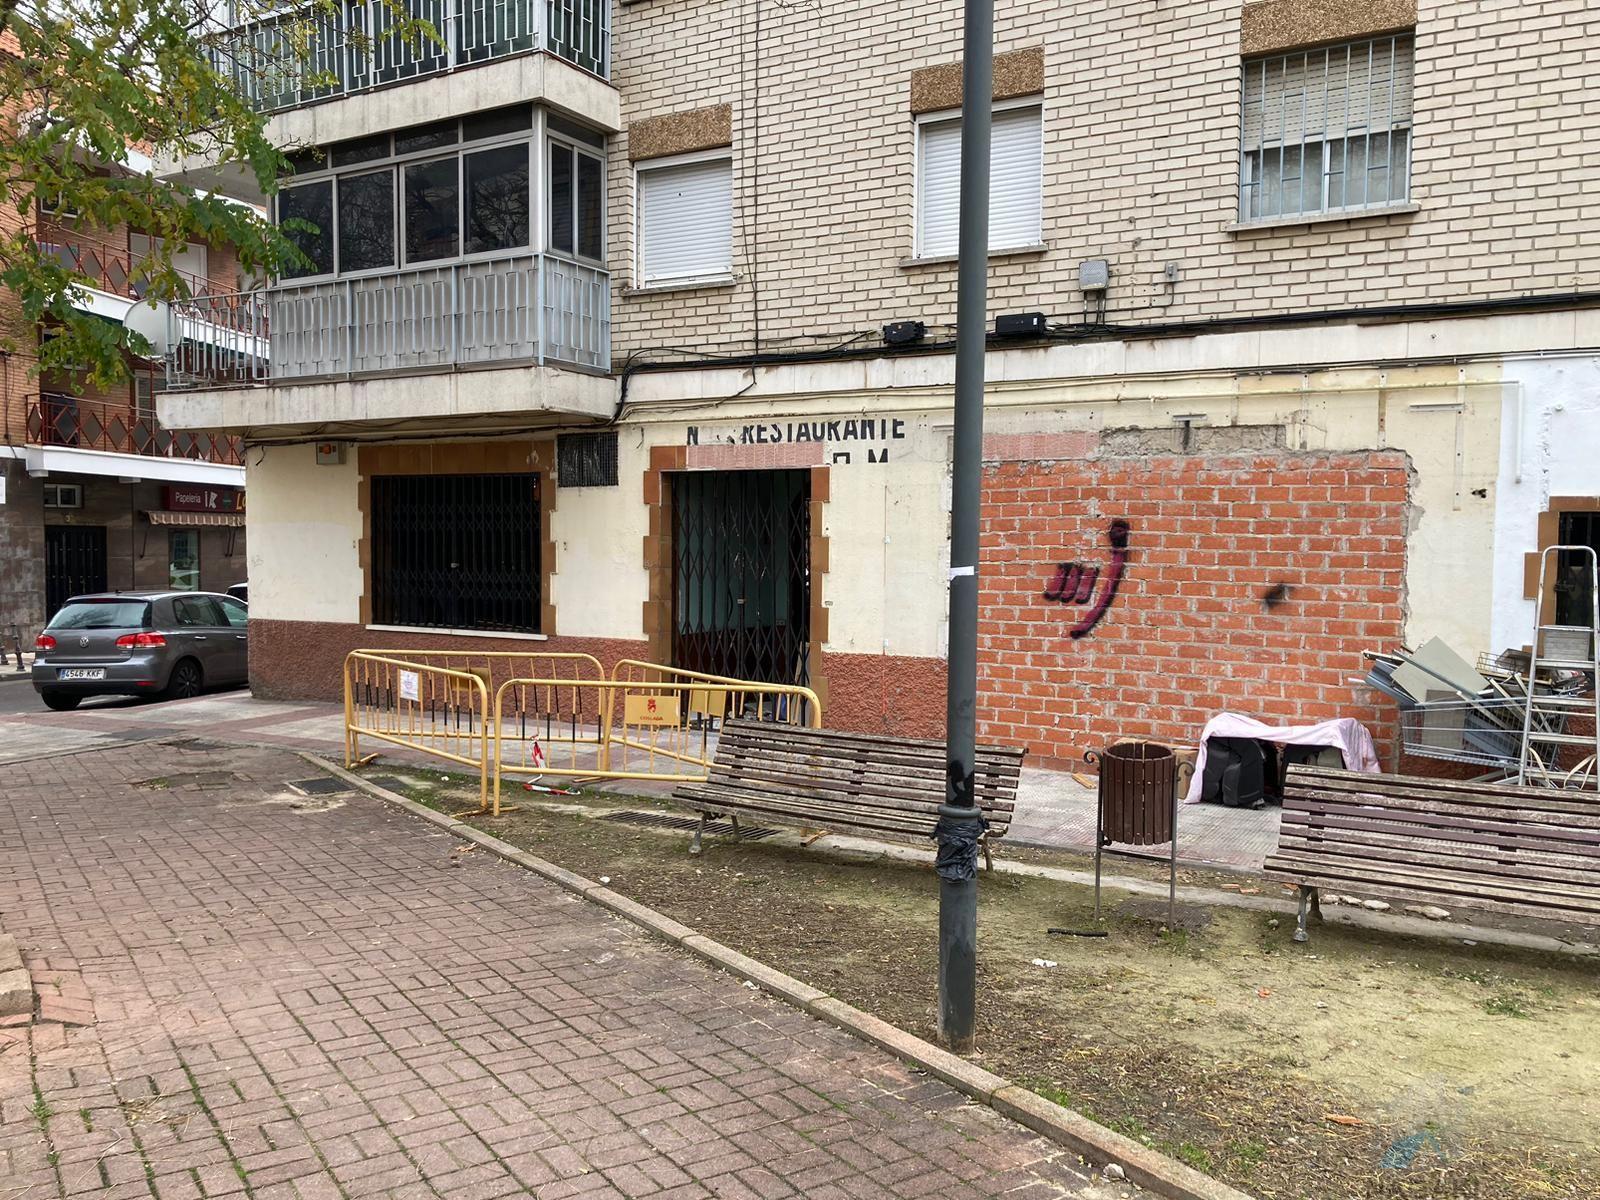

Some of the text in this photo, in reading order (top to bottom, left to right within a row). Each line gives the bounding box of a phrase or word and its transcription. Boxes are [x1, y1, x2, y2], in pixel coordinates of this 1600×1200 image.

[742, 418, 905, 445] RESTAURANTE
[65, 669, 102, 678] 4546 KKF
